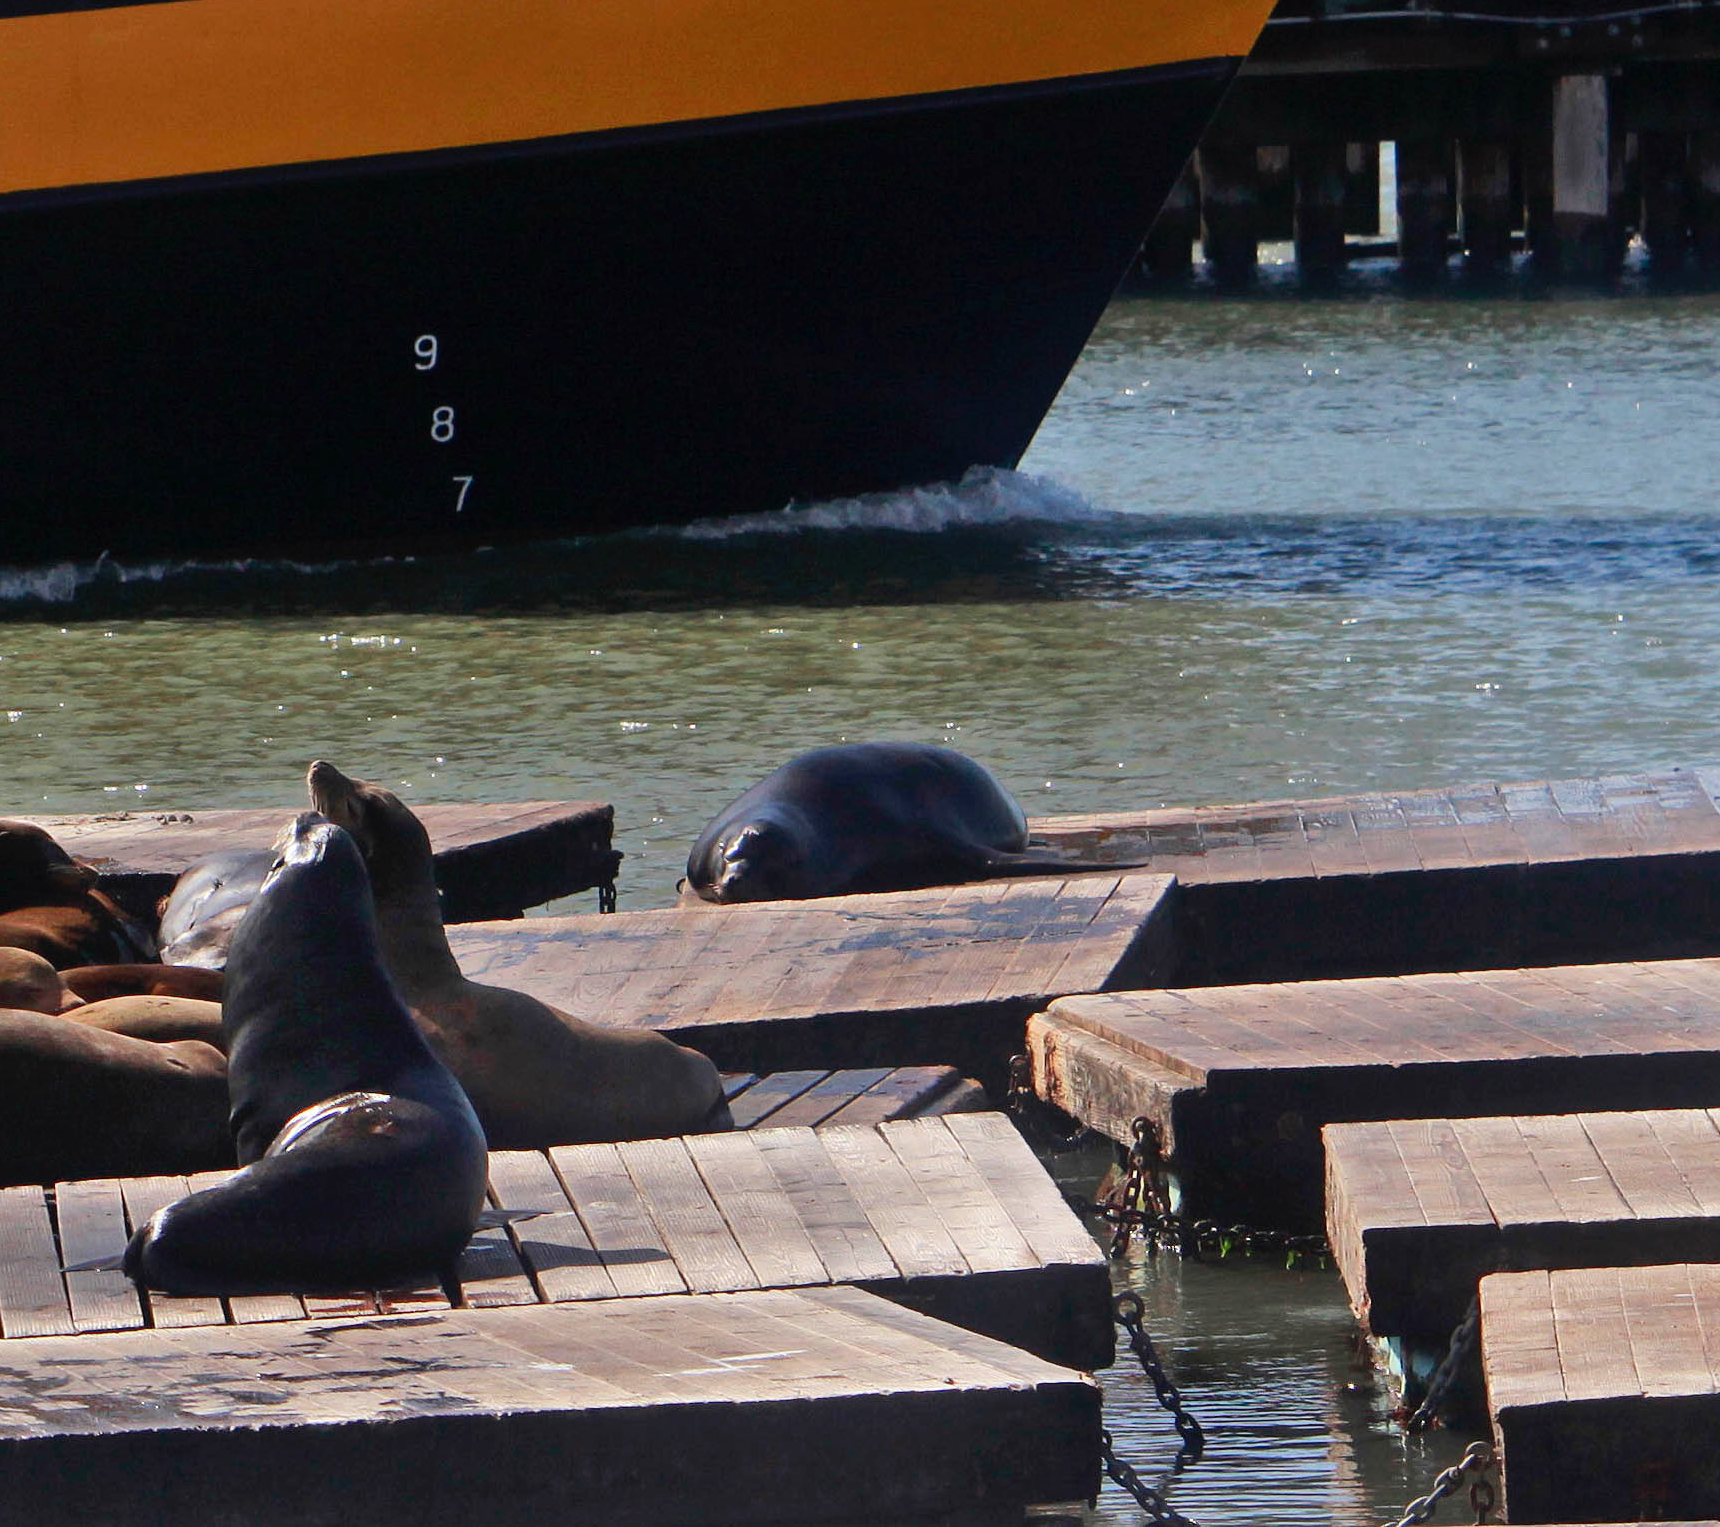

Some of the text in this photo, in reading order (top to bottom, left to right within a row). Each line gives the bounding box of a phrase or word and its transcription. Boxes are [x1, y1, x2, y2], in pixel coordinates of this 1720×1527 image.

[413, 334, 439, 371] 9
[430, 405, 455, 442] 8
[452, 475, 473, 512] 7
